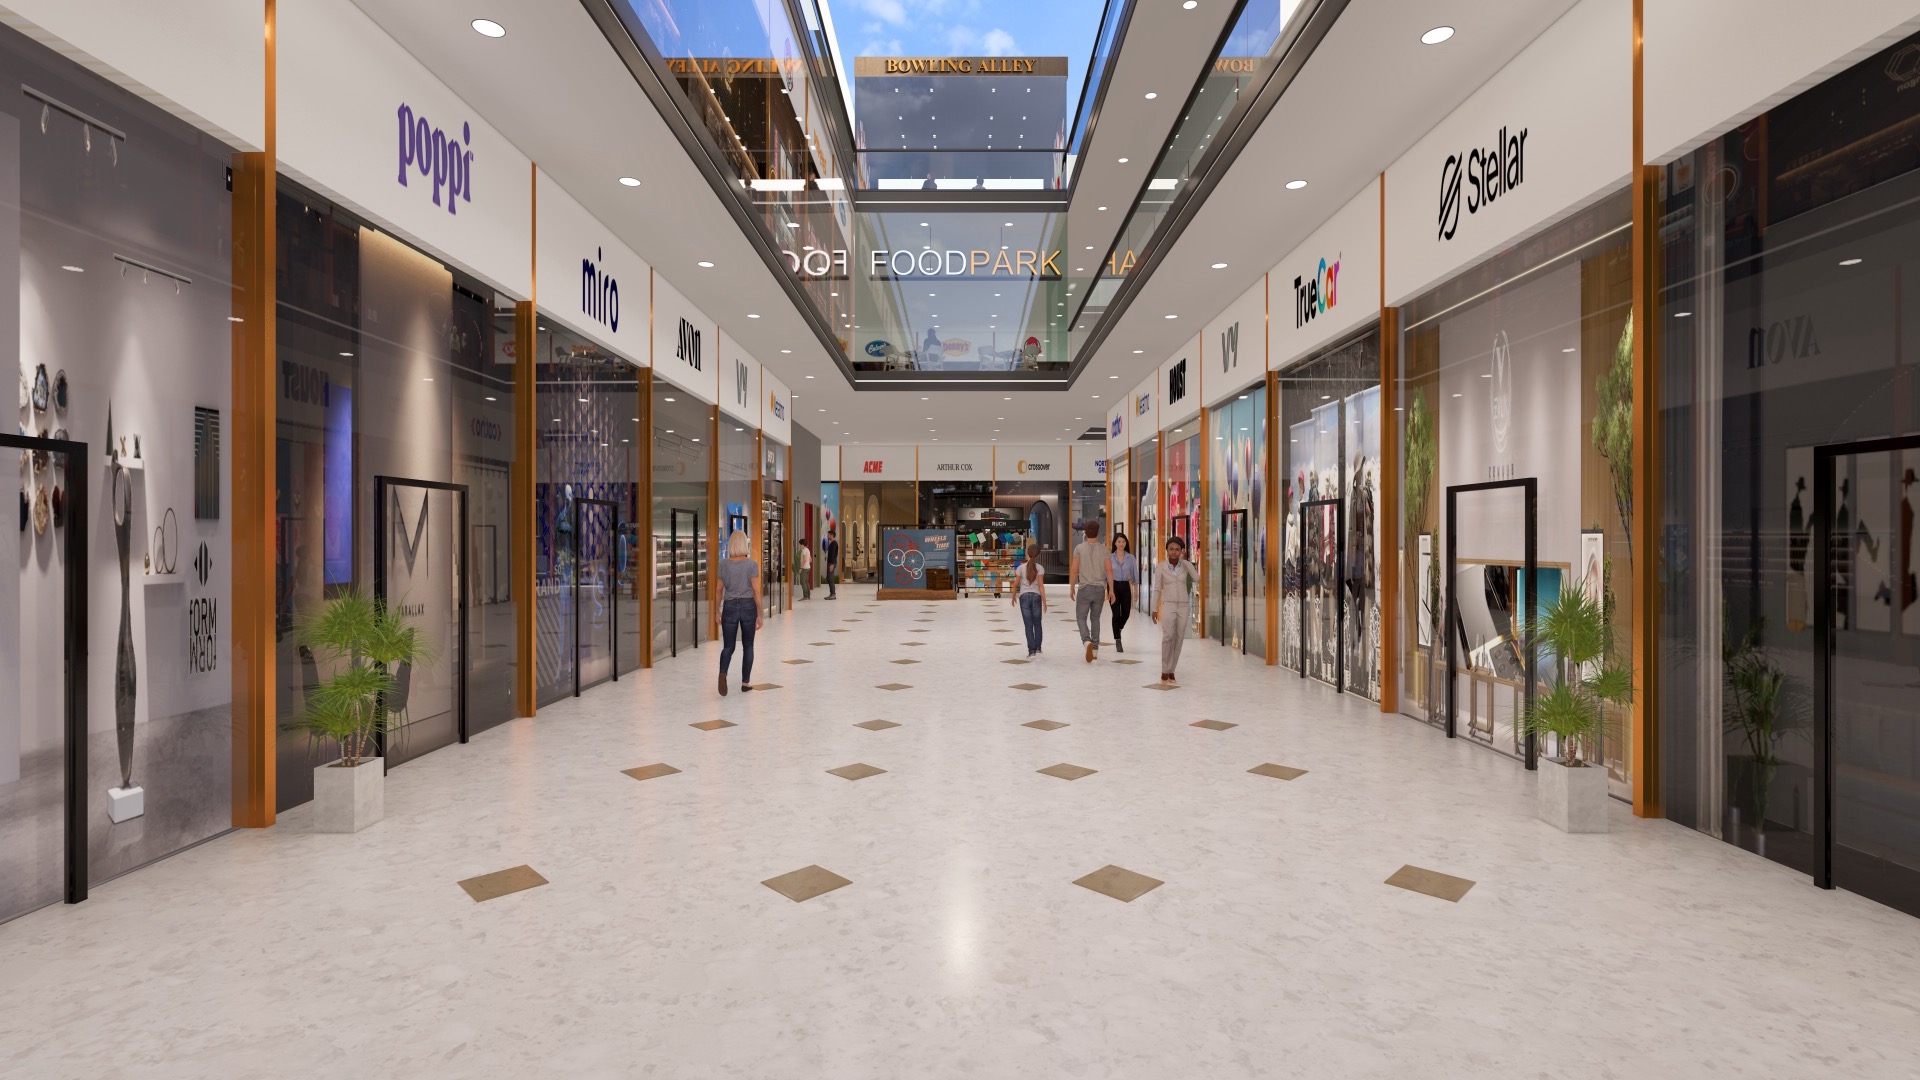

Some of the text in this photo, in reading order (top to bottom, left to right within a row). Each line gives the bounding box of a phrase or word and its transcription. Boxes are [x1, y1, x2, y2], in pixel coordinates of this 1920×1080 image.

[885, 58, 1037, 74] BOWLING ALLEY
[397, 101, 472, 216] poppi
[1467, 125, 1528, 214] Stellar
[582, 245, 619, 334] miro
[1293, 255, 1341, 330] TrueCar
[863, 460, 883, 473] ACME
[936, 463, 973, 471] ARTHUR COX
[1027, 463, 1051, 471] crossover
[399, 603, 425, 617] ARALLAX
